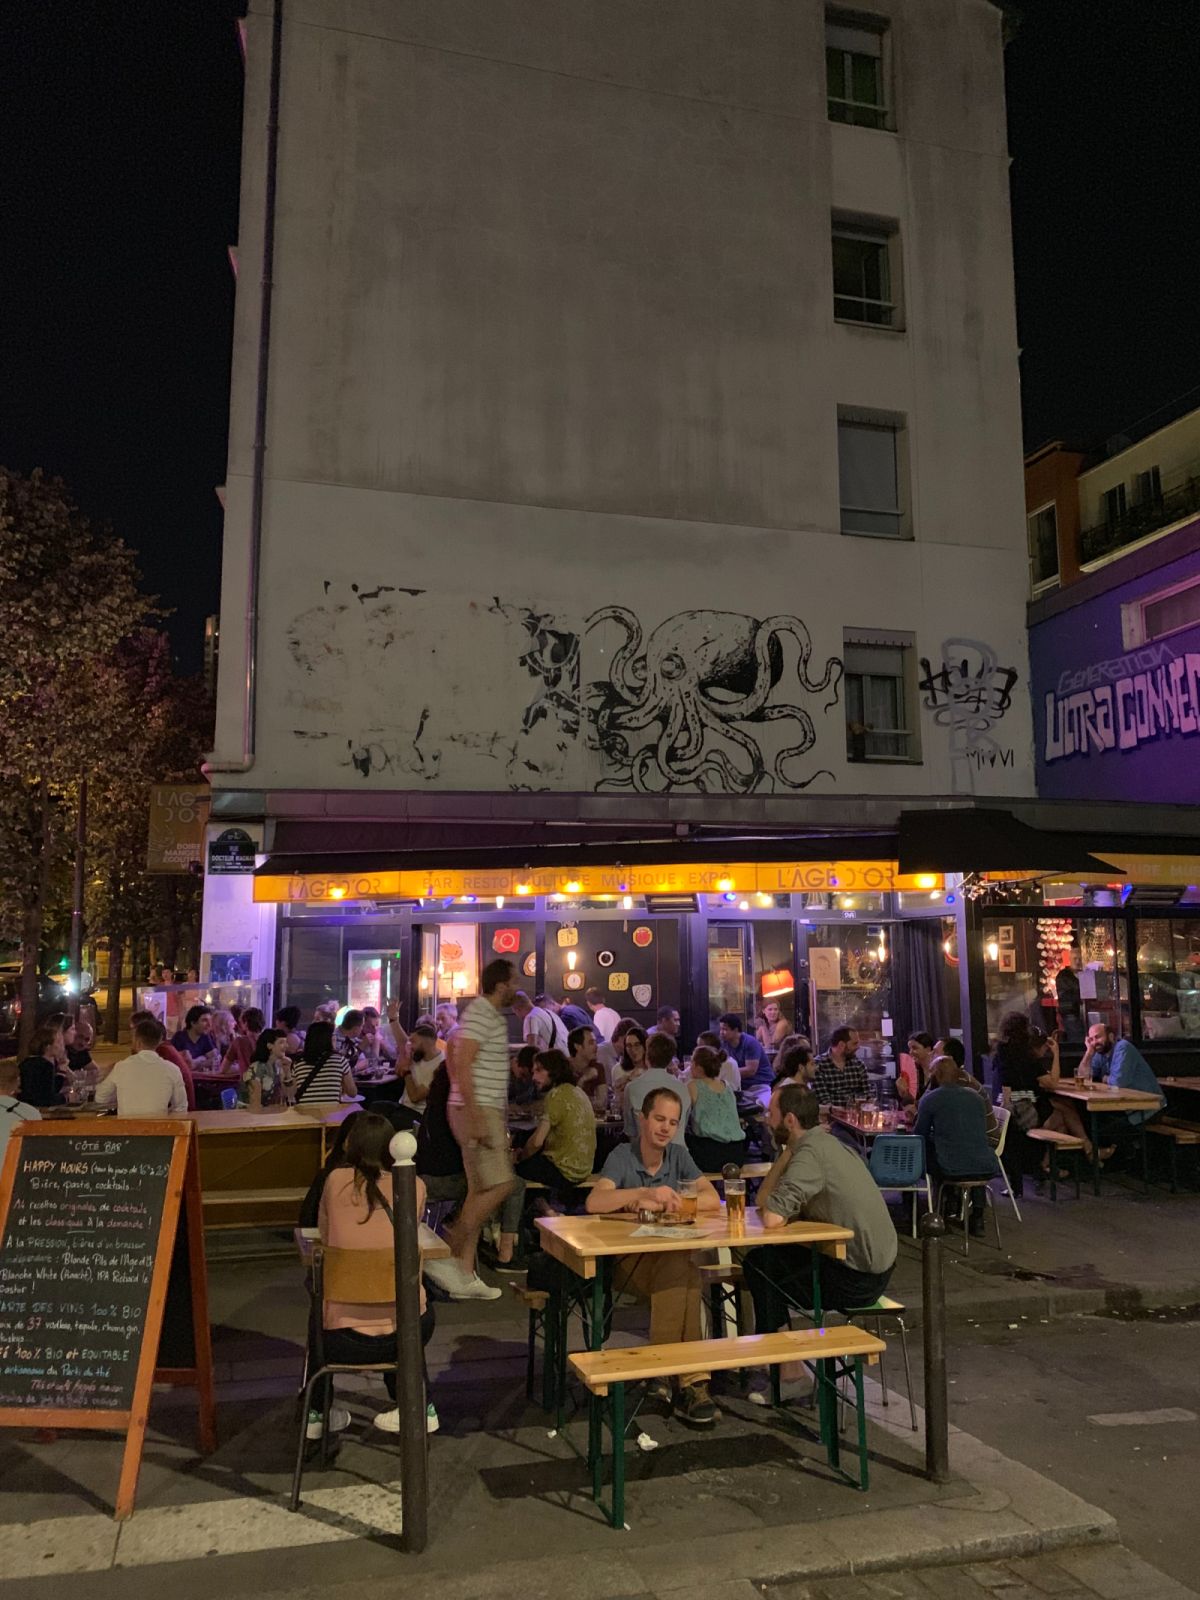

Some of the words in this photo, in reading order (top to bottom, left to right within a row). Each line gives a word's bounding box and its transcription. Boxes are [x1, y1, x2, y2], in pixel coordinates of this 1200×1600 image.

[422, 877, 452, 889] BAR
[463, 876, 508, 889] RESTO
[601, 872, 676, 887] MUSIQUE
[689, 871, 731, 885] EXPO
[23, 1160, 57, 1174] HAPPY
[60, 1161, 89, 1174] HOURS
[99, 1202, 110, 1212] de
[113, 1202, 147, 1214] cocktails
[18, 1216, 27, 1226] et
[30, 1215, 42, 1226] les
[96, 1217, 105, 1228] la
[106, 1218, 144, 1229] demande
[16, 1236, 25, 1247] la
[62, 1252, 90, 1265] Blonde
[108, 1255, 118, 1266] de
[0, 1268, 32, 1281] Blanche
[36, 1267, 58, 1280] White
[0, 1302, 26, 1313] ARTE
[32, 1302, 53, 1313] DES
[59, 1303, 84, 1314] VINS
[122, 1305, 142, 1319] BIO
[45, 1348, 64, 1360] BIO
[66, 1348, 79, 1360] et
[47, 1365, 58, 1376] du
[96, 1366, 111, 1378] thé
